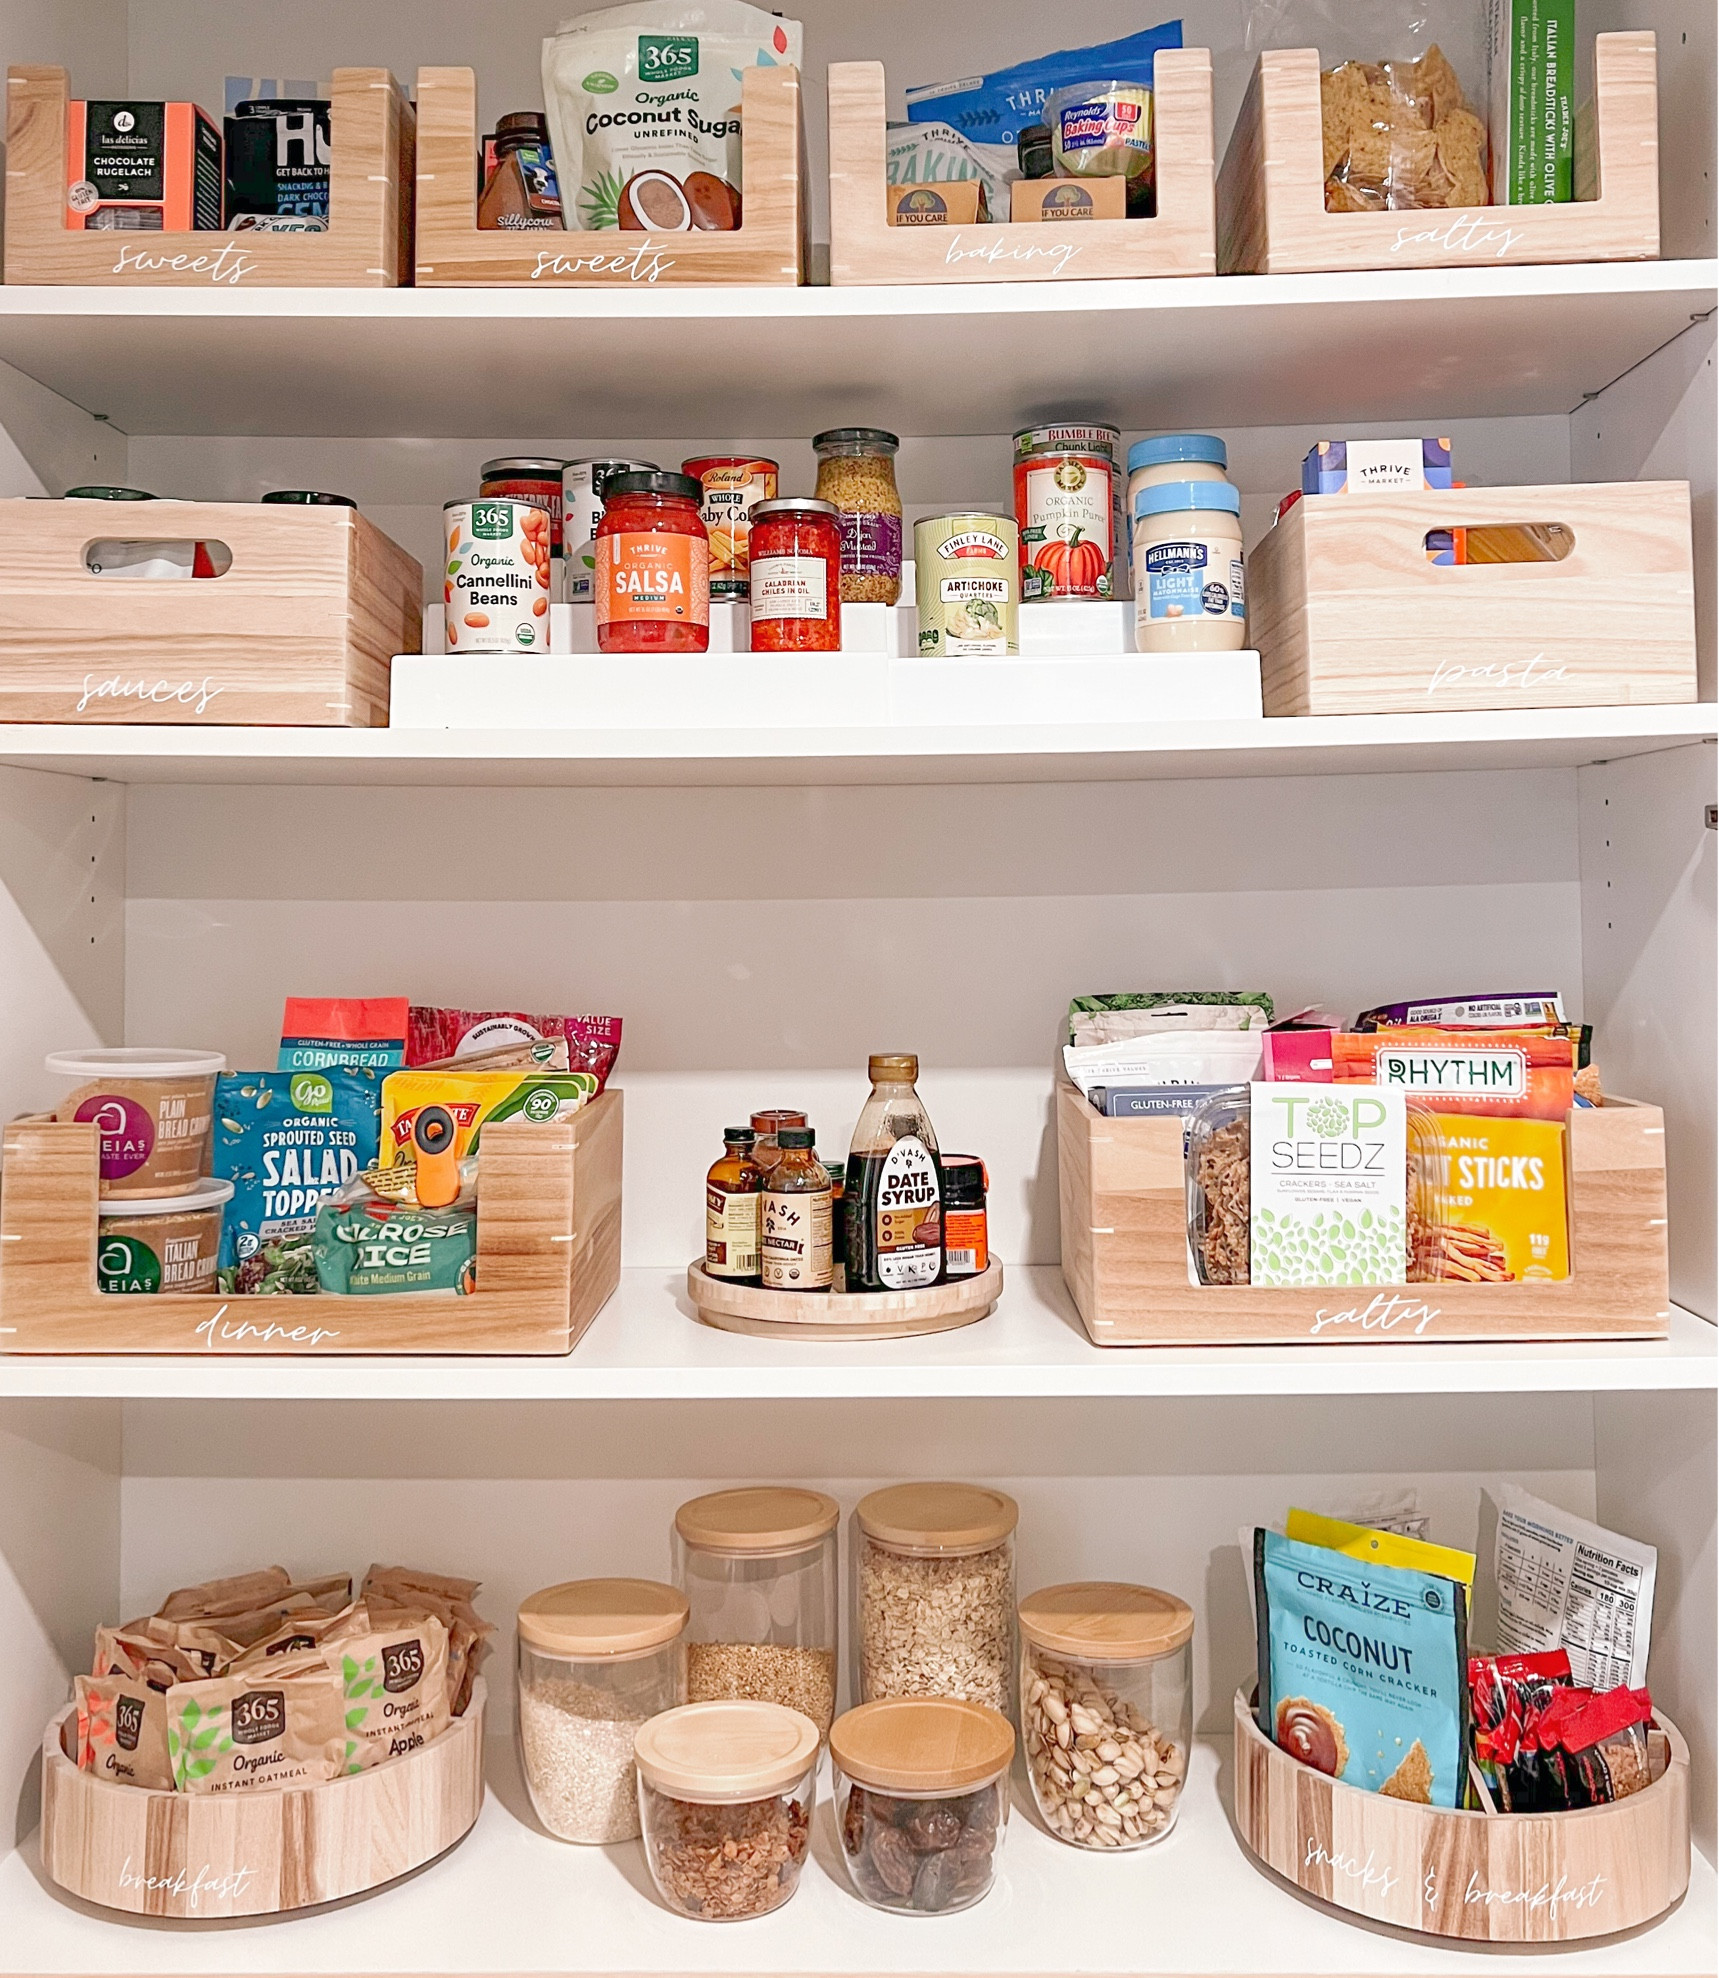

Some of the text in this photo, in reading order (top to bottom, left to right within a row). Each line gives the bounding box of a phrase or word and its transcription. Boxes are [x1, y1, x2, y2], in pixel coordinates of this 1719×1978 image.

[645, 44, 692, 70] 365
[635, 89, 700, 107] Organic
[1065, 106, 1101, 121] Reynolds
[1121, 106, 1132, 114] 50
[1544, 19, 1557, 197] ITALIAN BREADSTICKS WITH OLIVE
[1560, 96, 1570, 125] TRADER
[586, 107, 681, 135] Coconut
[1064, 118, 1135, 138] Baking Cups
[102, 135, 114, 144] las
[634, 129, 699, 143] UNREFINED
[922, 128, 971, 150] THRIVE
[97, 168, 152, 176] RUGELACH
[276, 168, 290, 177] GET
[292, 168, 312, 177] BACK
[314, 168, 323, 176] TO
[277, 183, 314, 191] SNACKING
[277, 194, 300, 202] DARK
[896, 212, 948, 223] IF YOU CARE
[1042, 207, 1093, 217] IF YOU CARE
[1390, 213, 1525, 258] salty
[112, 240, 258, 284] sweets
[531, 239, 676, 283] sweets
[945, 233, 1083, 277] baking
[1048, 429, 1112, 441] BUMBLE BEE
[1055, 442, 1087, 451] Chunk
[708, 472, 744, 483] Roland
[1360, 465, 1411, 477] THRIVE
[711, 494, 741, 503] WHOLE
[1045, 497, 1094, 506] ORGANIC
[475, 508, 509, 526] 365
[1033, 508, 1080, 523] Pumpkin
[630, 544, 669, 555] THRIVE
[944, 531, 1004, 553] FINLEY LANE
[471, 554, 515, 569] Organic
[1148, 546, 1204, 564] HELLMANN'S
[456, 574, 532, 589] Cannellini
[616, 570, 684, 594] SALSA
[947, 581, 1004, 592] ARTICHOKE
[1156, 577, 1194, 590] LIGHT
[470, 592, 518, 606] Beans
[762, 588, 785, 596] CHILES
[1153, 587, 1200, 596] MAYONNAISE
[1428, 652, 1577, 696] pasta
[76, 672, 225, 714] sauces
[577, 1014, 612, 1026] VALUE
[472, 1024, 536, 1041] SUSTAINABLY GROWN
[586, 1025, 611, 1036] SIZE
[298, 1040, 342, 1048] GLUTEN-FREE
[292, 1051, 389, 1067] CORNBREAD
[1388, 1058, 1513, 1087] RHYTHM
[159, 1100, 187, 1119] PLAIN
[531, 1099, 551, 1110] 90
[1131, 1099, 1193, 1110] GLUTEN-FREE
[158, 1119, 188, 1139] BREAD
[283, 1117, 339, 1127] ORGANIC
[263, 1131, 357, 1147] SPROUTED SEED
[124, 1152, 145, 1160] EVER
[892, 1148, 926, 1165] D'VASH
[1272, 1141, 1385, 1169] SEEDZ
[263, 1149, 358, 1187] SALAD
[1458, 1155, 1545, 1190] STICKS
[888, 1172, 929, 1189] DATE
[1279, 1180, 1327, 1188] CRACKERS
[882, 1187, 935, 1206] SYRUP
[264, 1225, 305, 1235] CRACKED
[165, 1240, 198, 1264] ITALIAN
[768, 1238, 796, 1249] NECTAR
[164, 1261, 195, 1283] BREAD
[371, 1270, 431, 1284] Medium Grain
[1310, 1292, 1442, 1335] salty
[195, 1303, 340, 1348] dinner
[1578, 1545, 1639, 1577] Nutrition Facts
[1570, 1581, 1592, 1595] Calories
[1600, 1592, 1634, 1611] 180 300
[1304, 1615, 1412, 1675] COCONUT
[389, 1649, 420, 1677] 365
[1283, 1641, 1438, 1699] TOASTED CORN CRACKER
[118, 1704, 140, 1733] 365
[238, 1697, 280, 1726] 365
[366, 1723, 406, 1738] INSTANT
[388, 1731, 425, 1756] Apple
[106, 1753, 135, 1777] Organic
[233, 1750, 286, 1774] Organic
[211, 1767, 308, 1792] INSTANT OATMEAL
[118, 1855, 258, 1909] breakfast
[1304, 1836, 1400, 1898] snacks
[1465, 1870, 1608, 1921] breakfast
